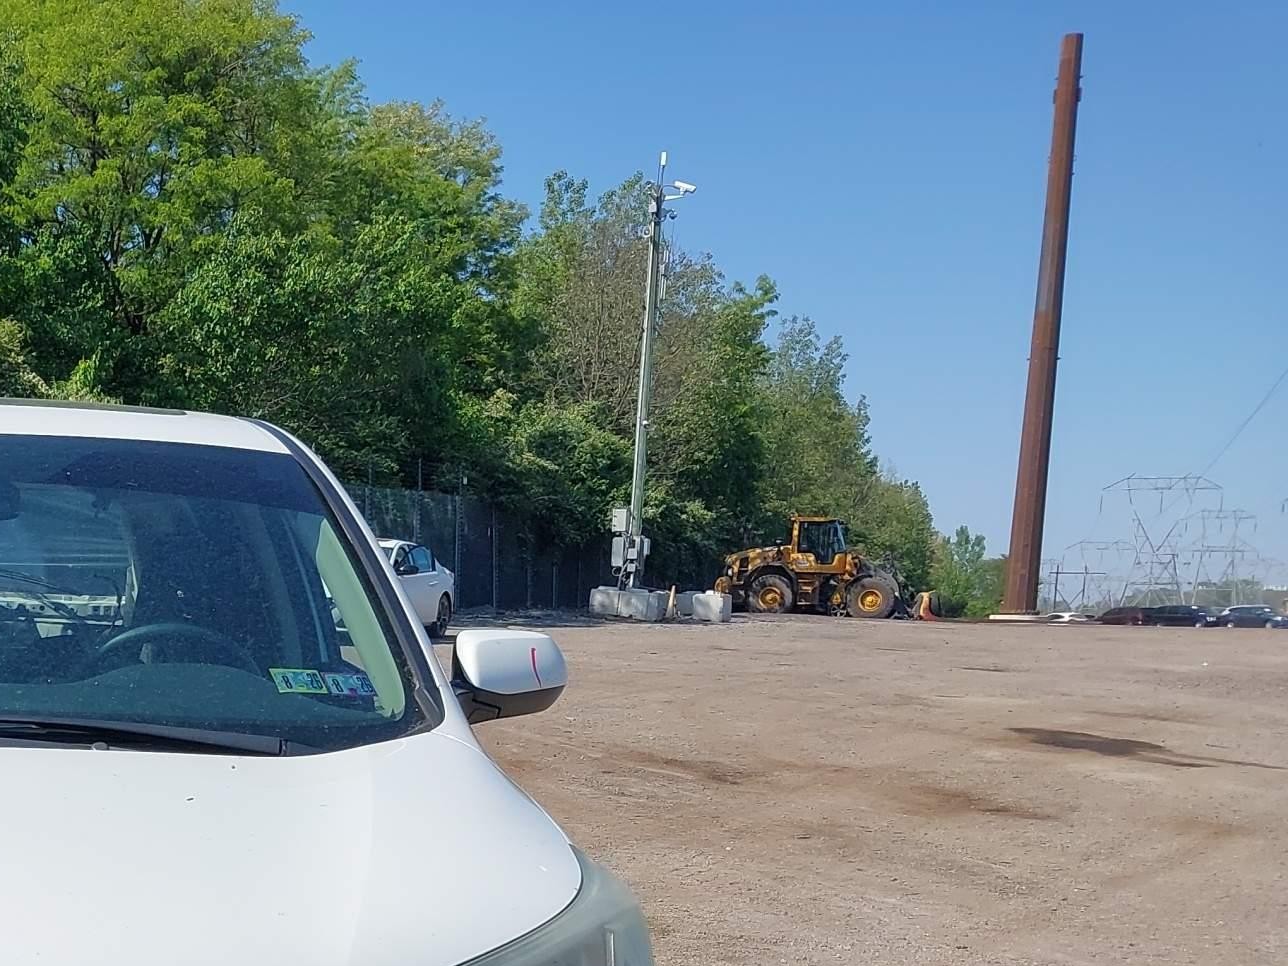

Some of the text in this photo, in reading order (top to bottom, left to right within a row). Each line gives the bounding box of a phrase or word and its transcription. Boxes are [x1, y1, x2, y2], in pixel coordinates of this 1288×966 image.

[282, 672, 323, 690] 8 26
[332, 678, 344, 692] 8
